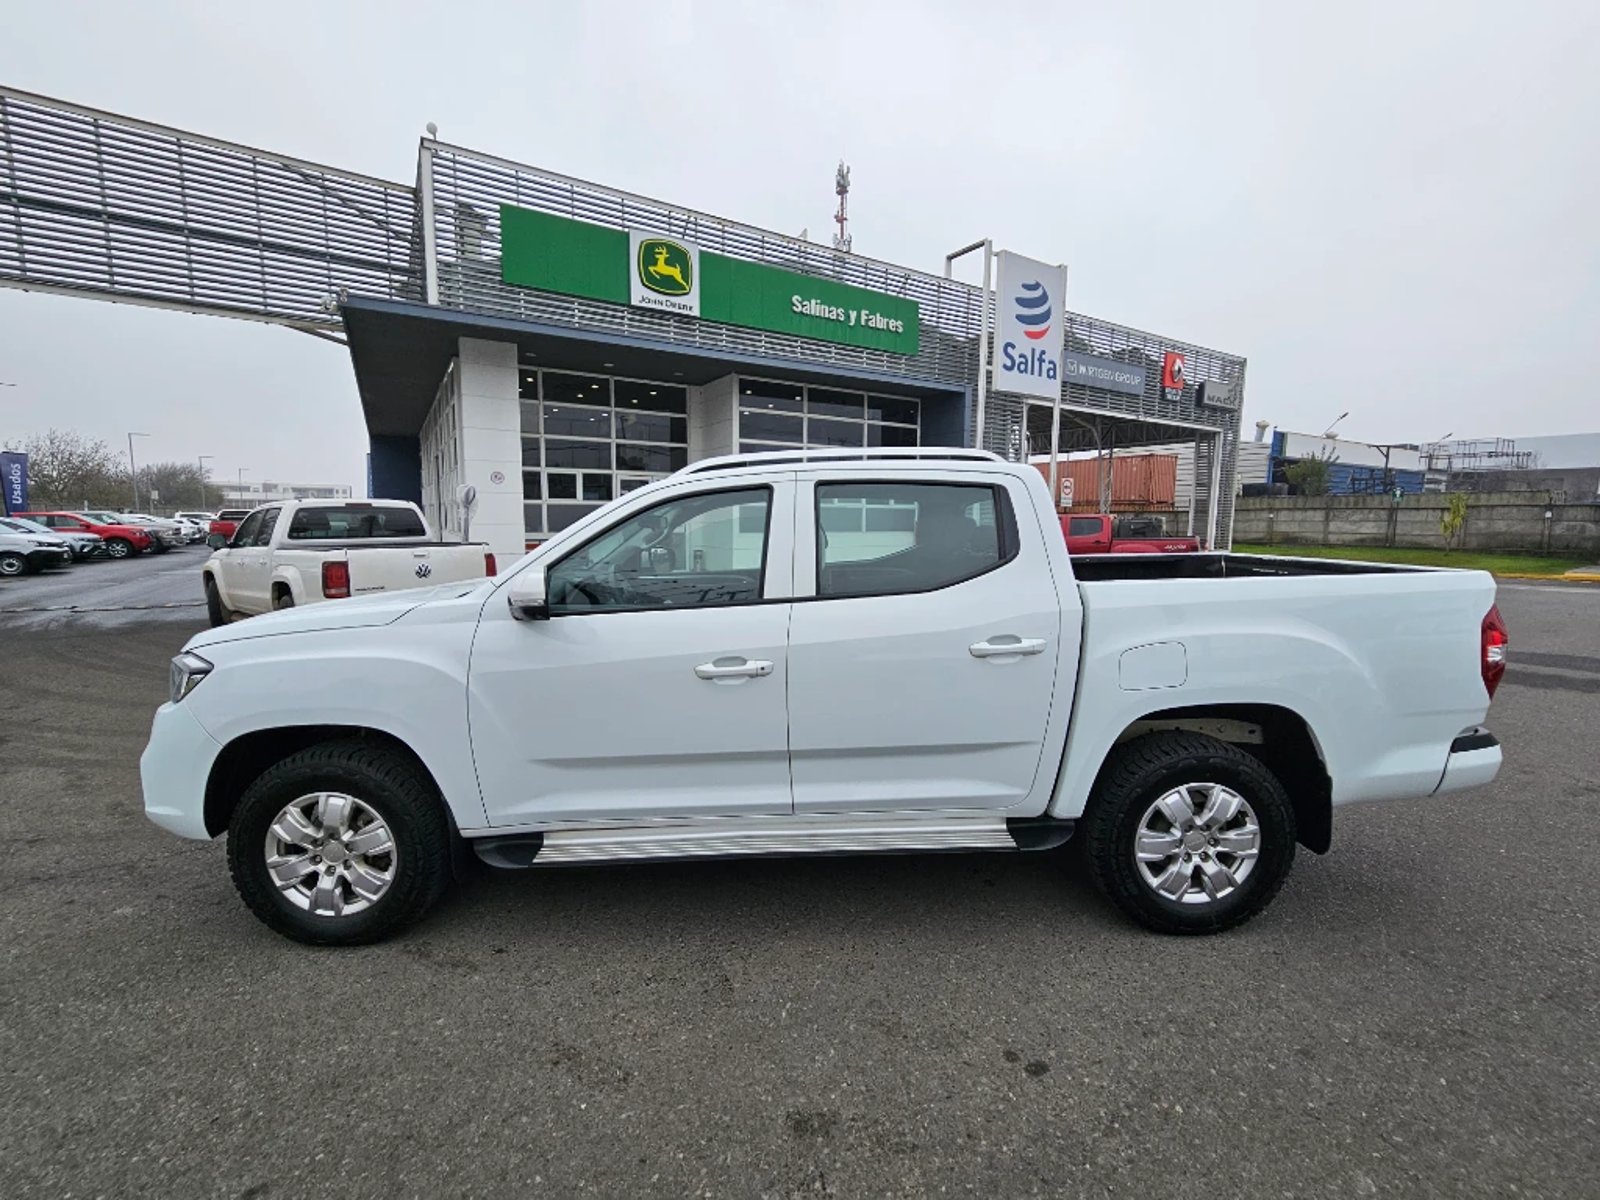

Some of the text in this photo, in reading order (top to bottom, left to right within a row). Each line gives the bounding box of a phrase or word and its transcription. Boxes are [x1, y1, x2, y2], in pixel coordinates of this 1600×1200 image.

[792, 295, 904, 333] Salinas y Fabres
[1003, 341, 1057, 380] Salfa
[1115, 371, 1141, 385] GROUP
[9, 463, 22, 504] Usados
